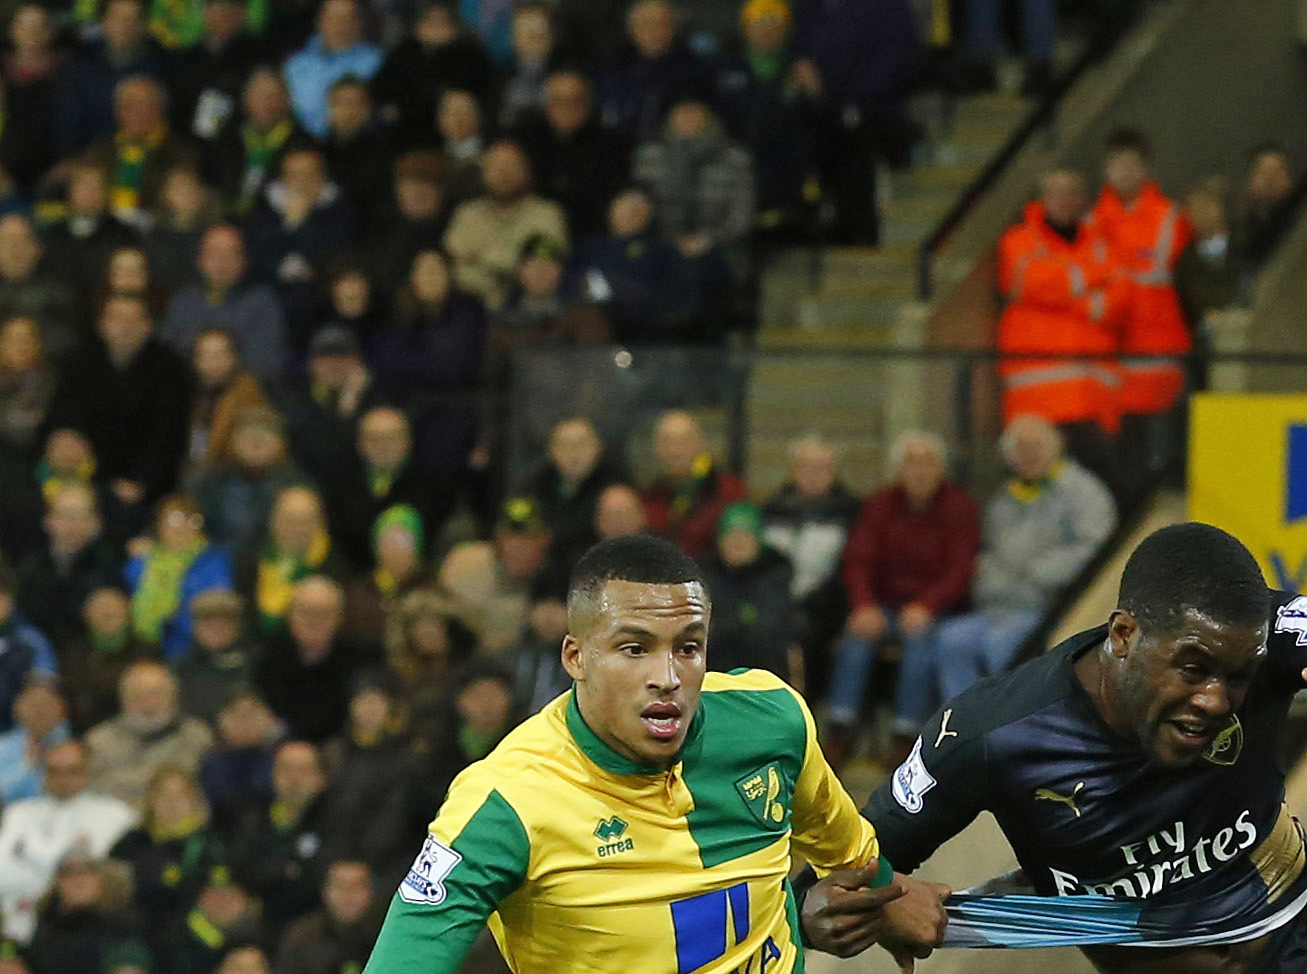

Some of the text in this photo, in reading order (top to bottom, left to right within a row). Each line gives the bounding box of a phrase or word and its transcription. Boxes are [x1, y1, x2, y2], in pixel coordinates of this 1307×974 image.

[597, 837, 634, 857] errea
[1048, 810, 1258, 899] Emirates
[1121, 821, 1186, 865] Fly
